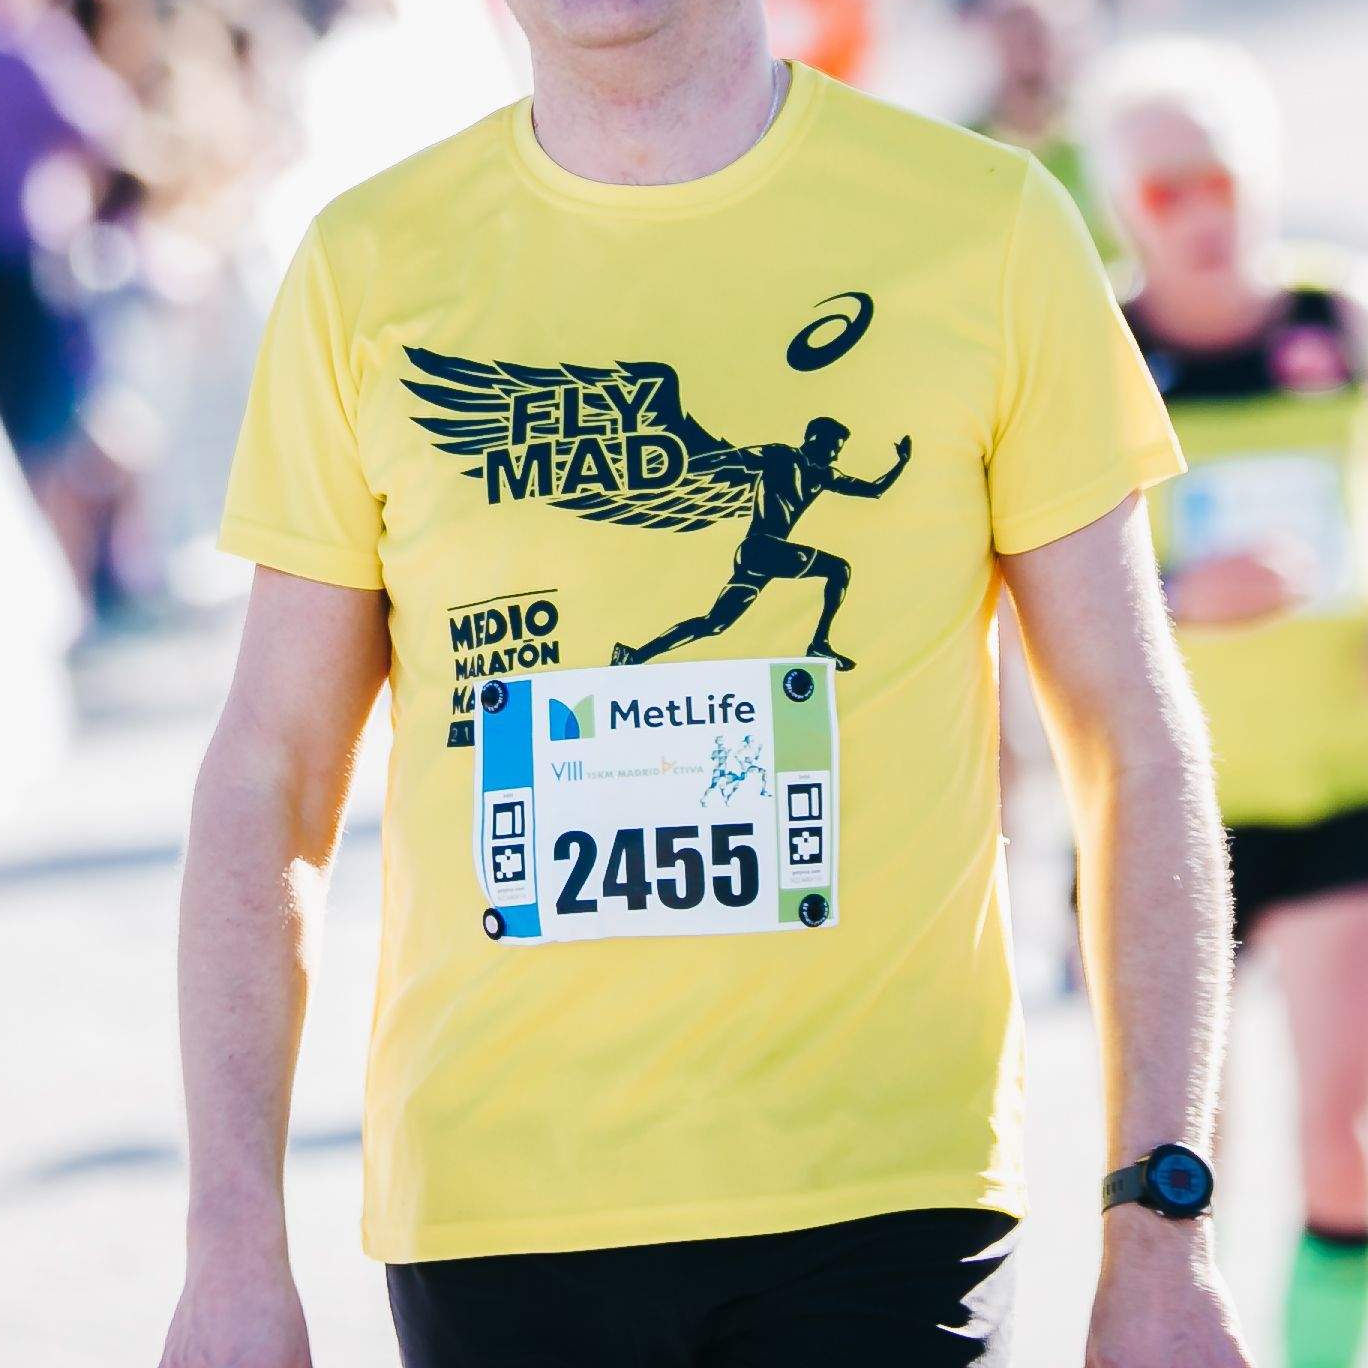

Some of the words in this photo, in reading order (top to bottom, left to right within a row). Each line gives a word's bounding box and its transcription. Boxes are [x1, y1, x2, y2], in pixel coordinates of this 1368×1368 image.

[511, 379, 661, 446] FLY
[486, 434, 685, 504] MAD
[450, 600, 559, 652] MEDIO
[610, 693, 755, 730] MetLife
[551, 761, 583, 781] VIII
[552, 822, 760, 916] 2455
